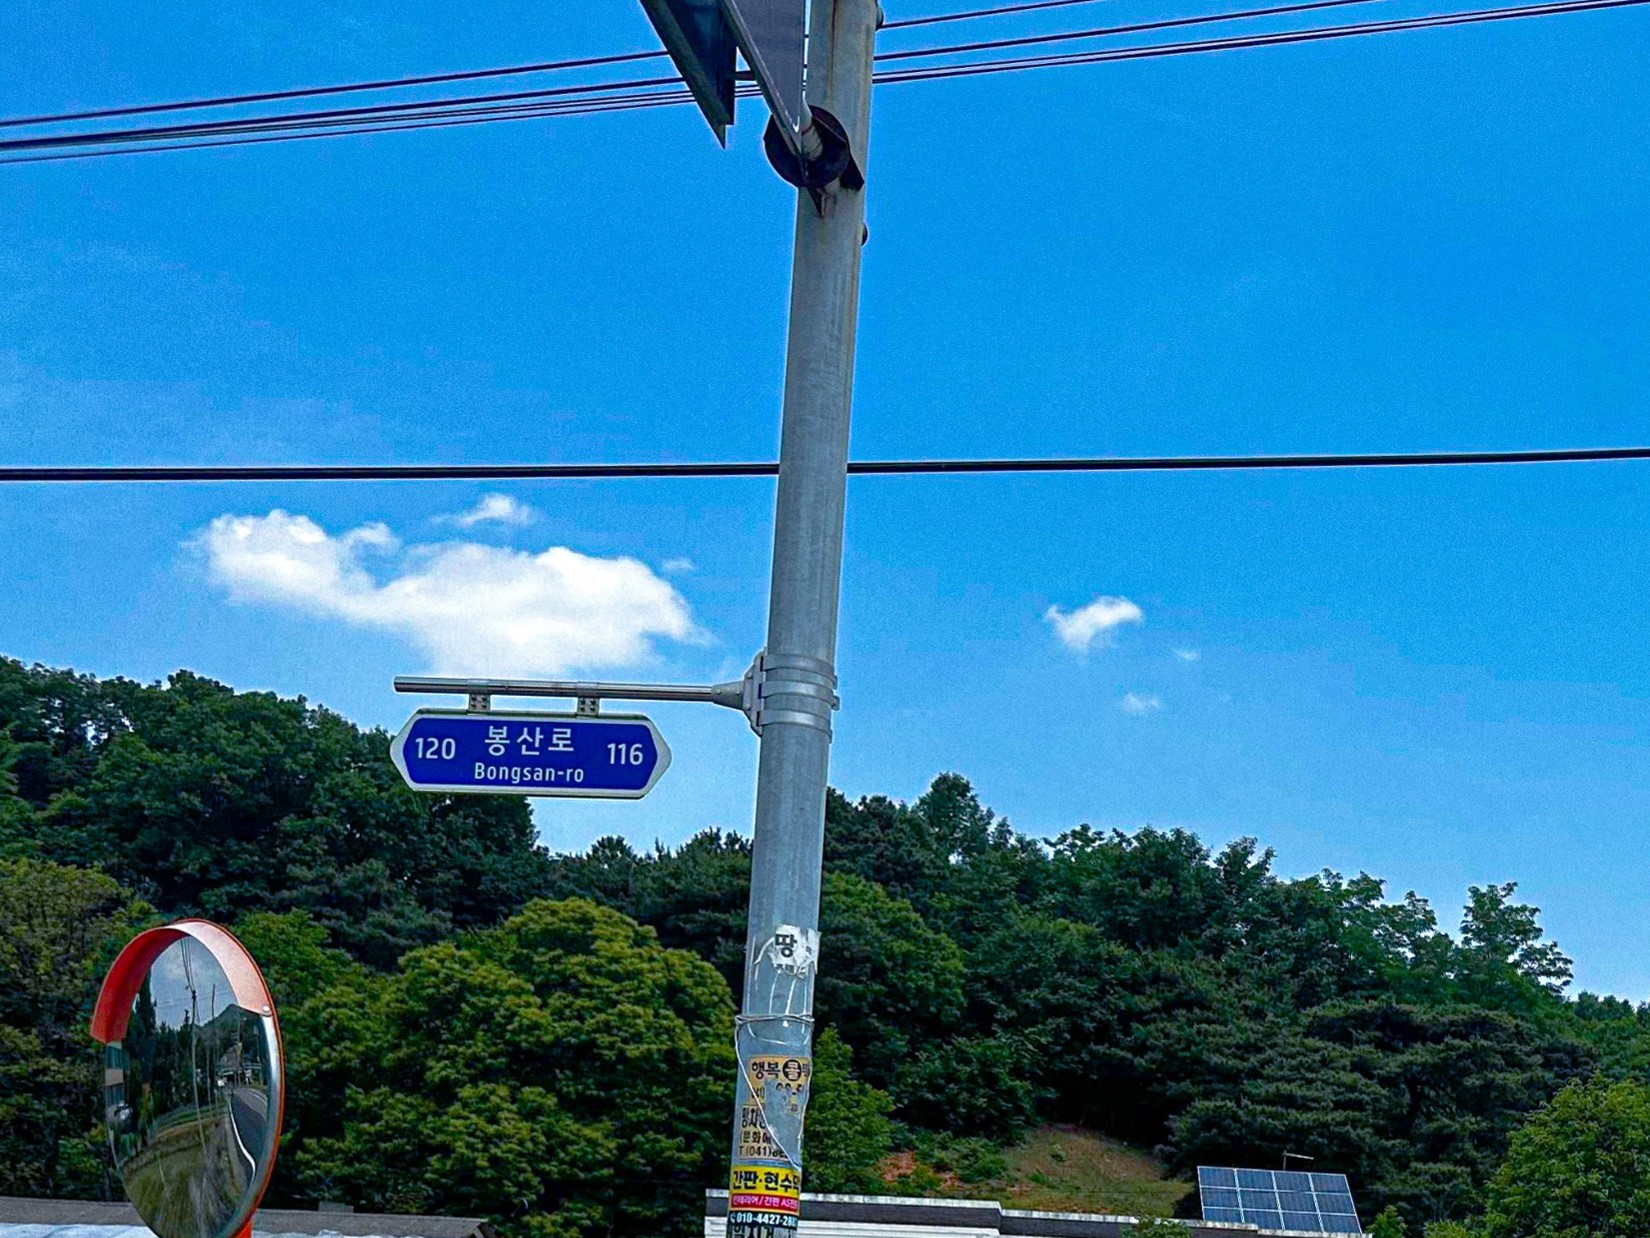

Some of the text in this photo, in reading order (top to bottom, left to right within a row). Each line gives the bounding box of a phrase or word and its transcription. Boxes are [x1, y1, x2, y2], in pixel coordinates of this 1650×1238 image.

[414, 725, 644, 765] 120 봉산로 116
[473, 762, 585, 784] Bongsan-ro
